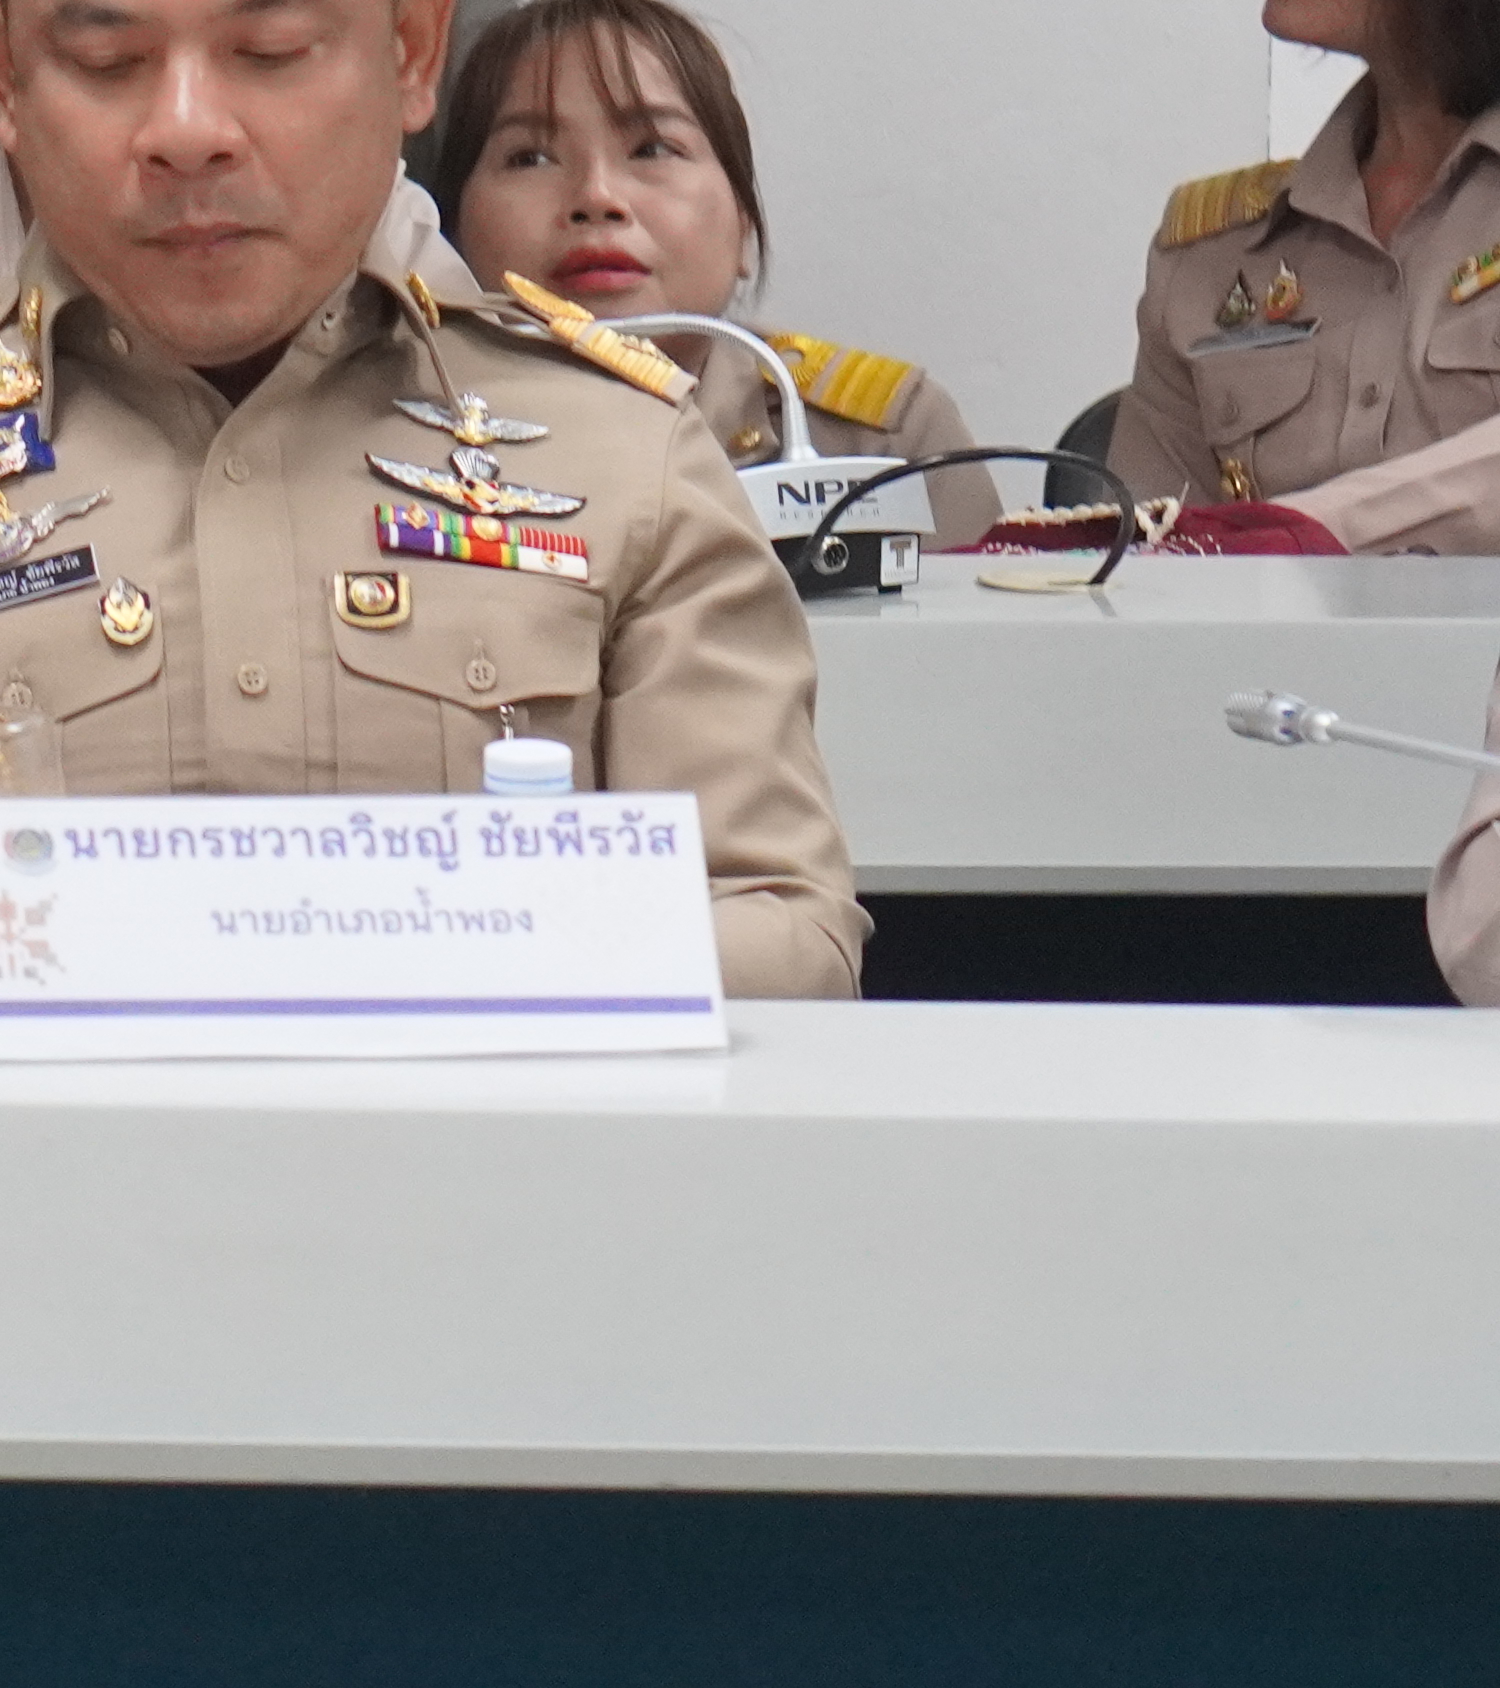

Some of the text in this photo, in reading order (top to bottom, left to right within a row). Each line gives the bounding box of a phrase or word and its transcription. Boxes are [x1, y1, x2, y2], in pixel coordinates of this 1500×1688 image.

[64, 809, 460, 872] นายกรชวาลวิชญ์
[209, 885, 535, 936] นายอำเภอน้ำพอง
